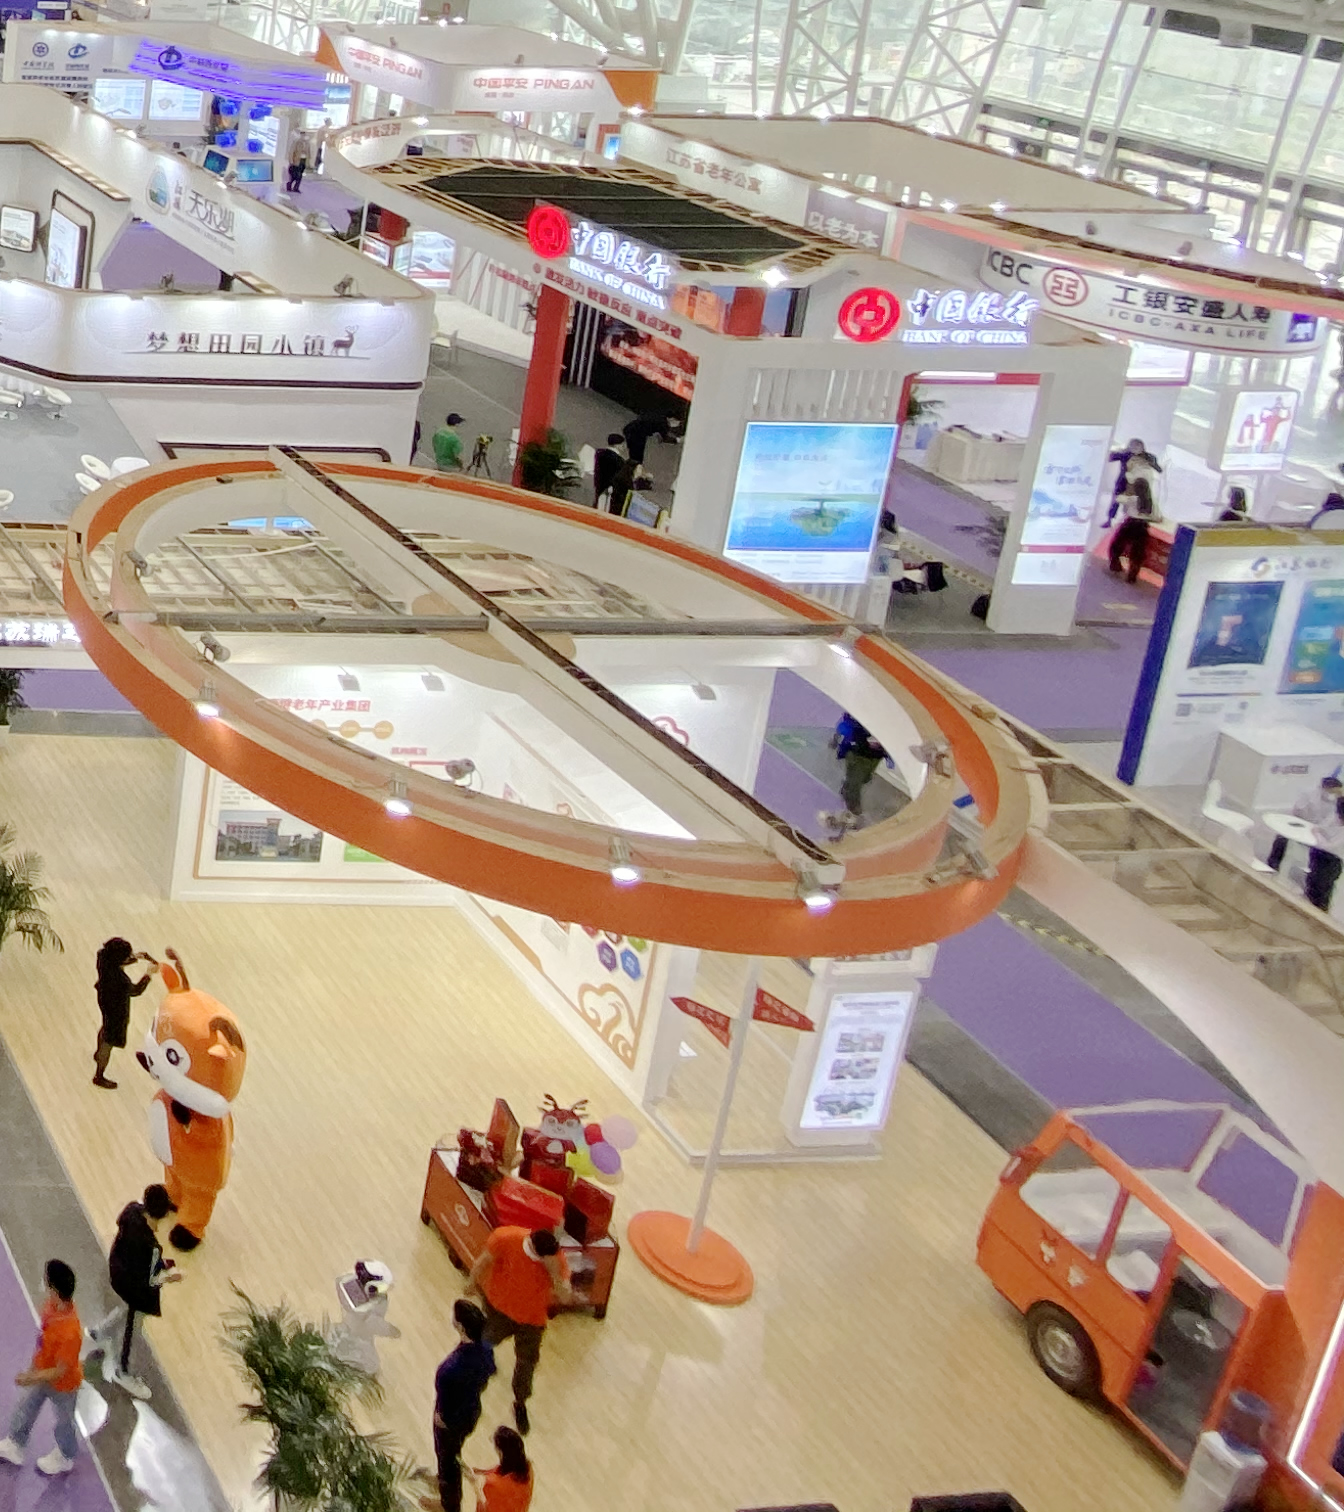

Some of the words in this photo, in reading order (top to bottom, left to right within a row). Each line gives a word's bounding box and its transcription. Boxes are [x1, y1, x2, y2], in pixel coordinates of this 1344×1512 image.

[473, 76, 529, 91] 中国平安
[665, 146, 763, 195] 江苏省老年公寓
[808, 210, 881, 249] 以老为本
[570, 220, 672, 289] 中国银行
[986, 245, 1034, 286] ICBC
[1111, 283, 1273, 324] 工银安盛人寿
[145, 331, 326, 358] 梦想田园小镇
